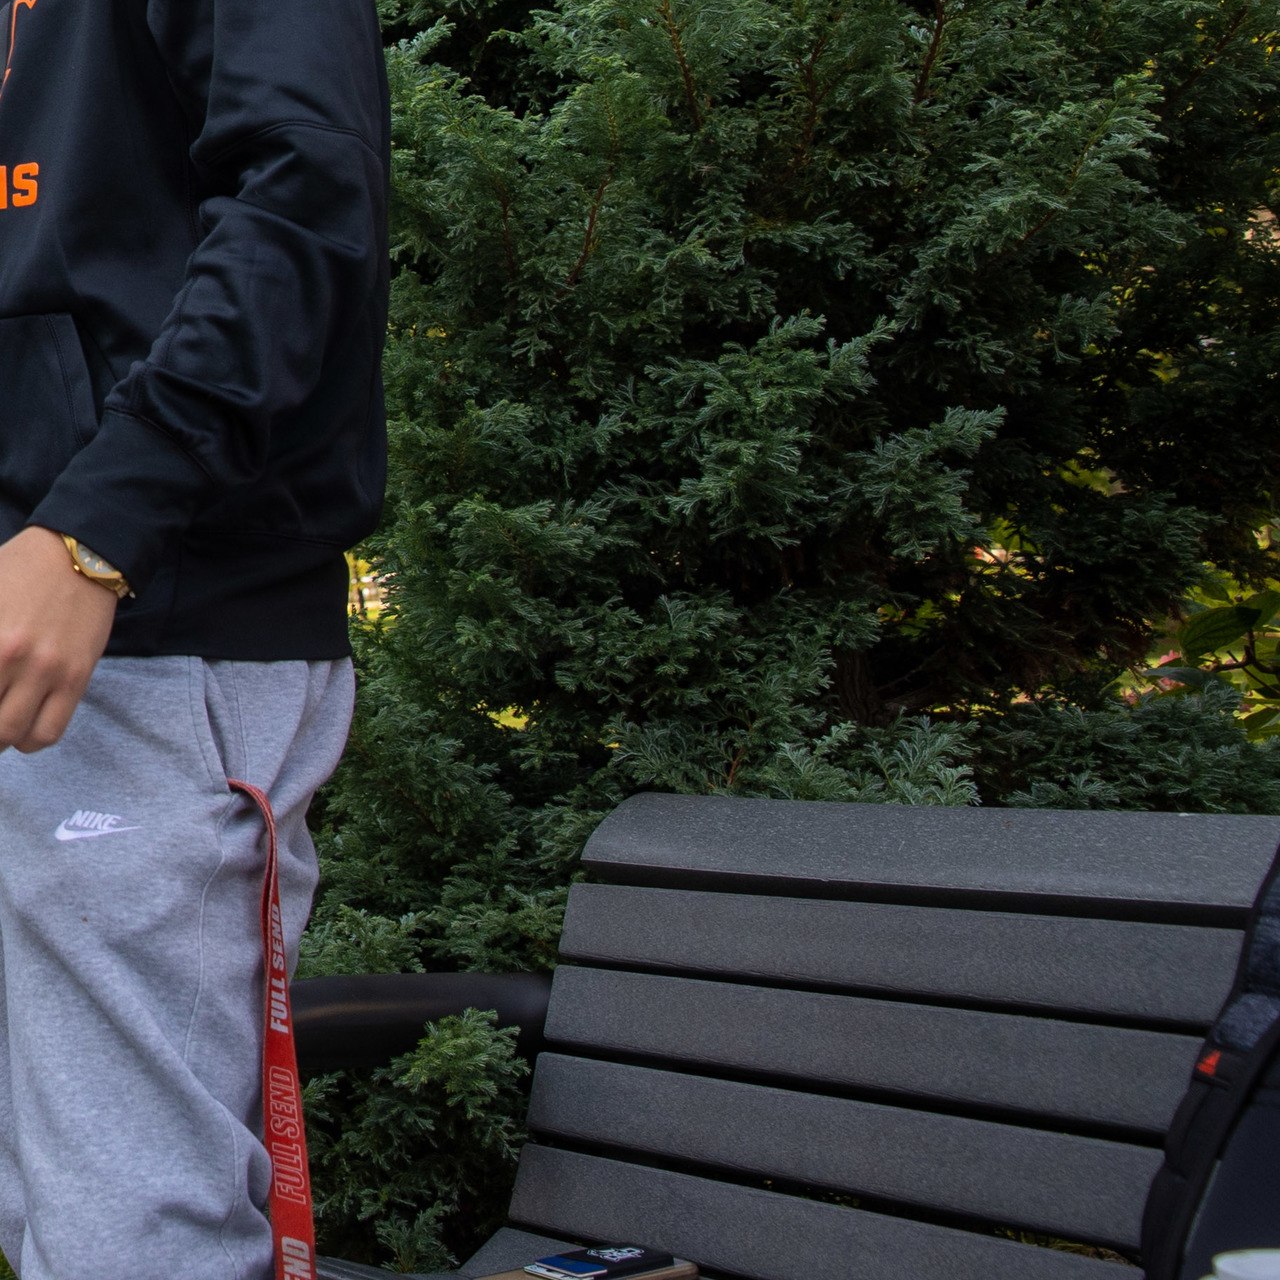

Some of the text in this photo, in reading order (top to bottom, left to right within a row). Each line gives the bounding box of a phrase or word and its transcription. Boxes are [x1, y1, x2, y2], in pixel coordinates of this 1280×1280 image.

[67, 809, 122, 830] NIKE
[270, 903, 289, 1034] FULL SEND
[269, 1065, 307, 1205] FULL SEND
